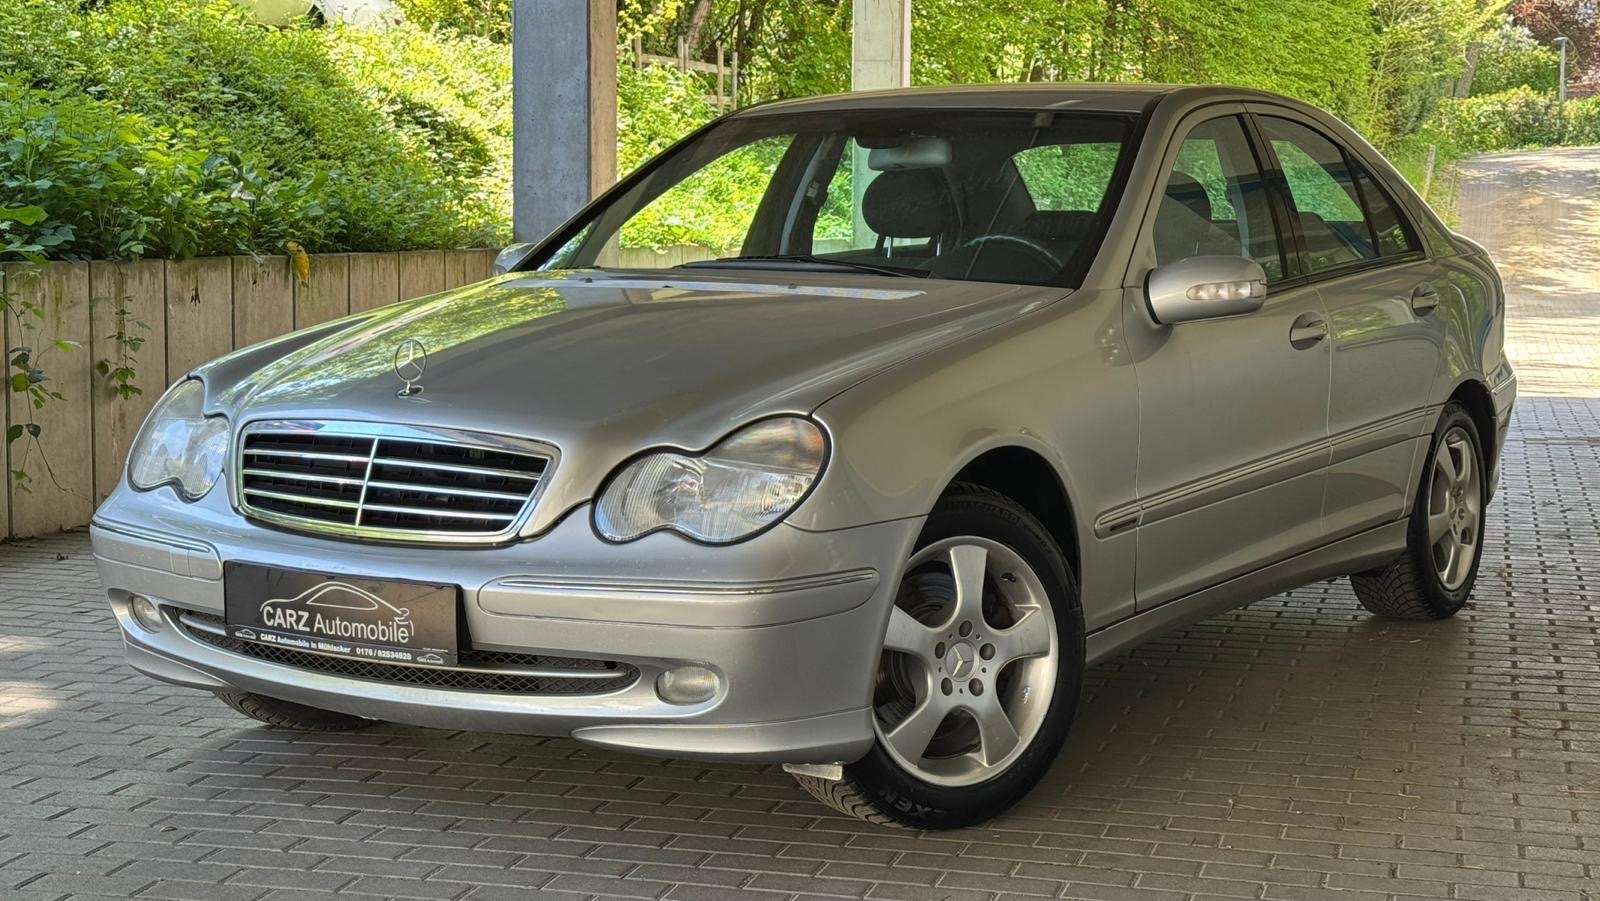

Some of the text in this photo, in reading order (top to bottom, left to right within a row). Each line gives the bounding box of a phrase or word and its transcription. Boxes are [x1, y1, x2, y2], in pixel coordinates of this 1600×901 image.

[263, 605, 409, 643] CARZ Automobile
[260, 632, 277, 642] CARZ
